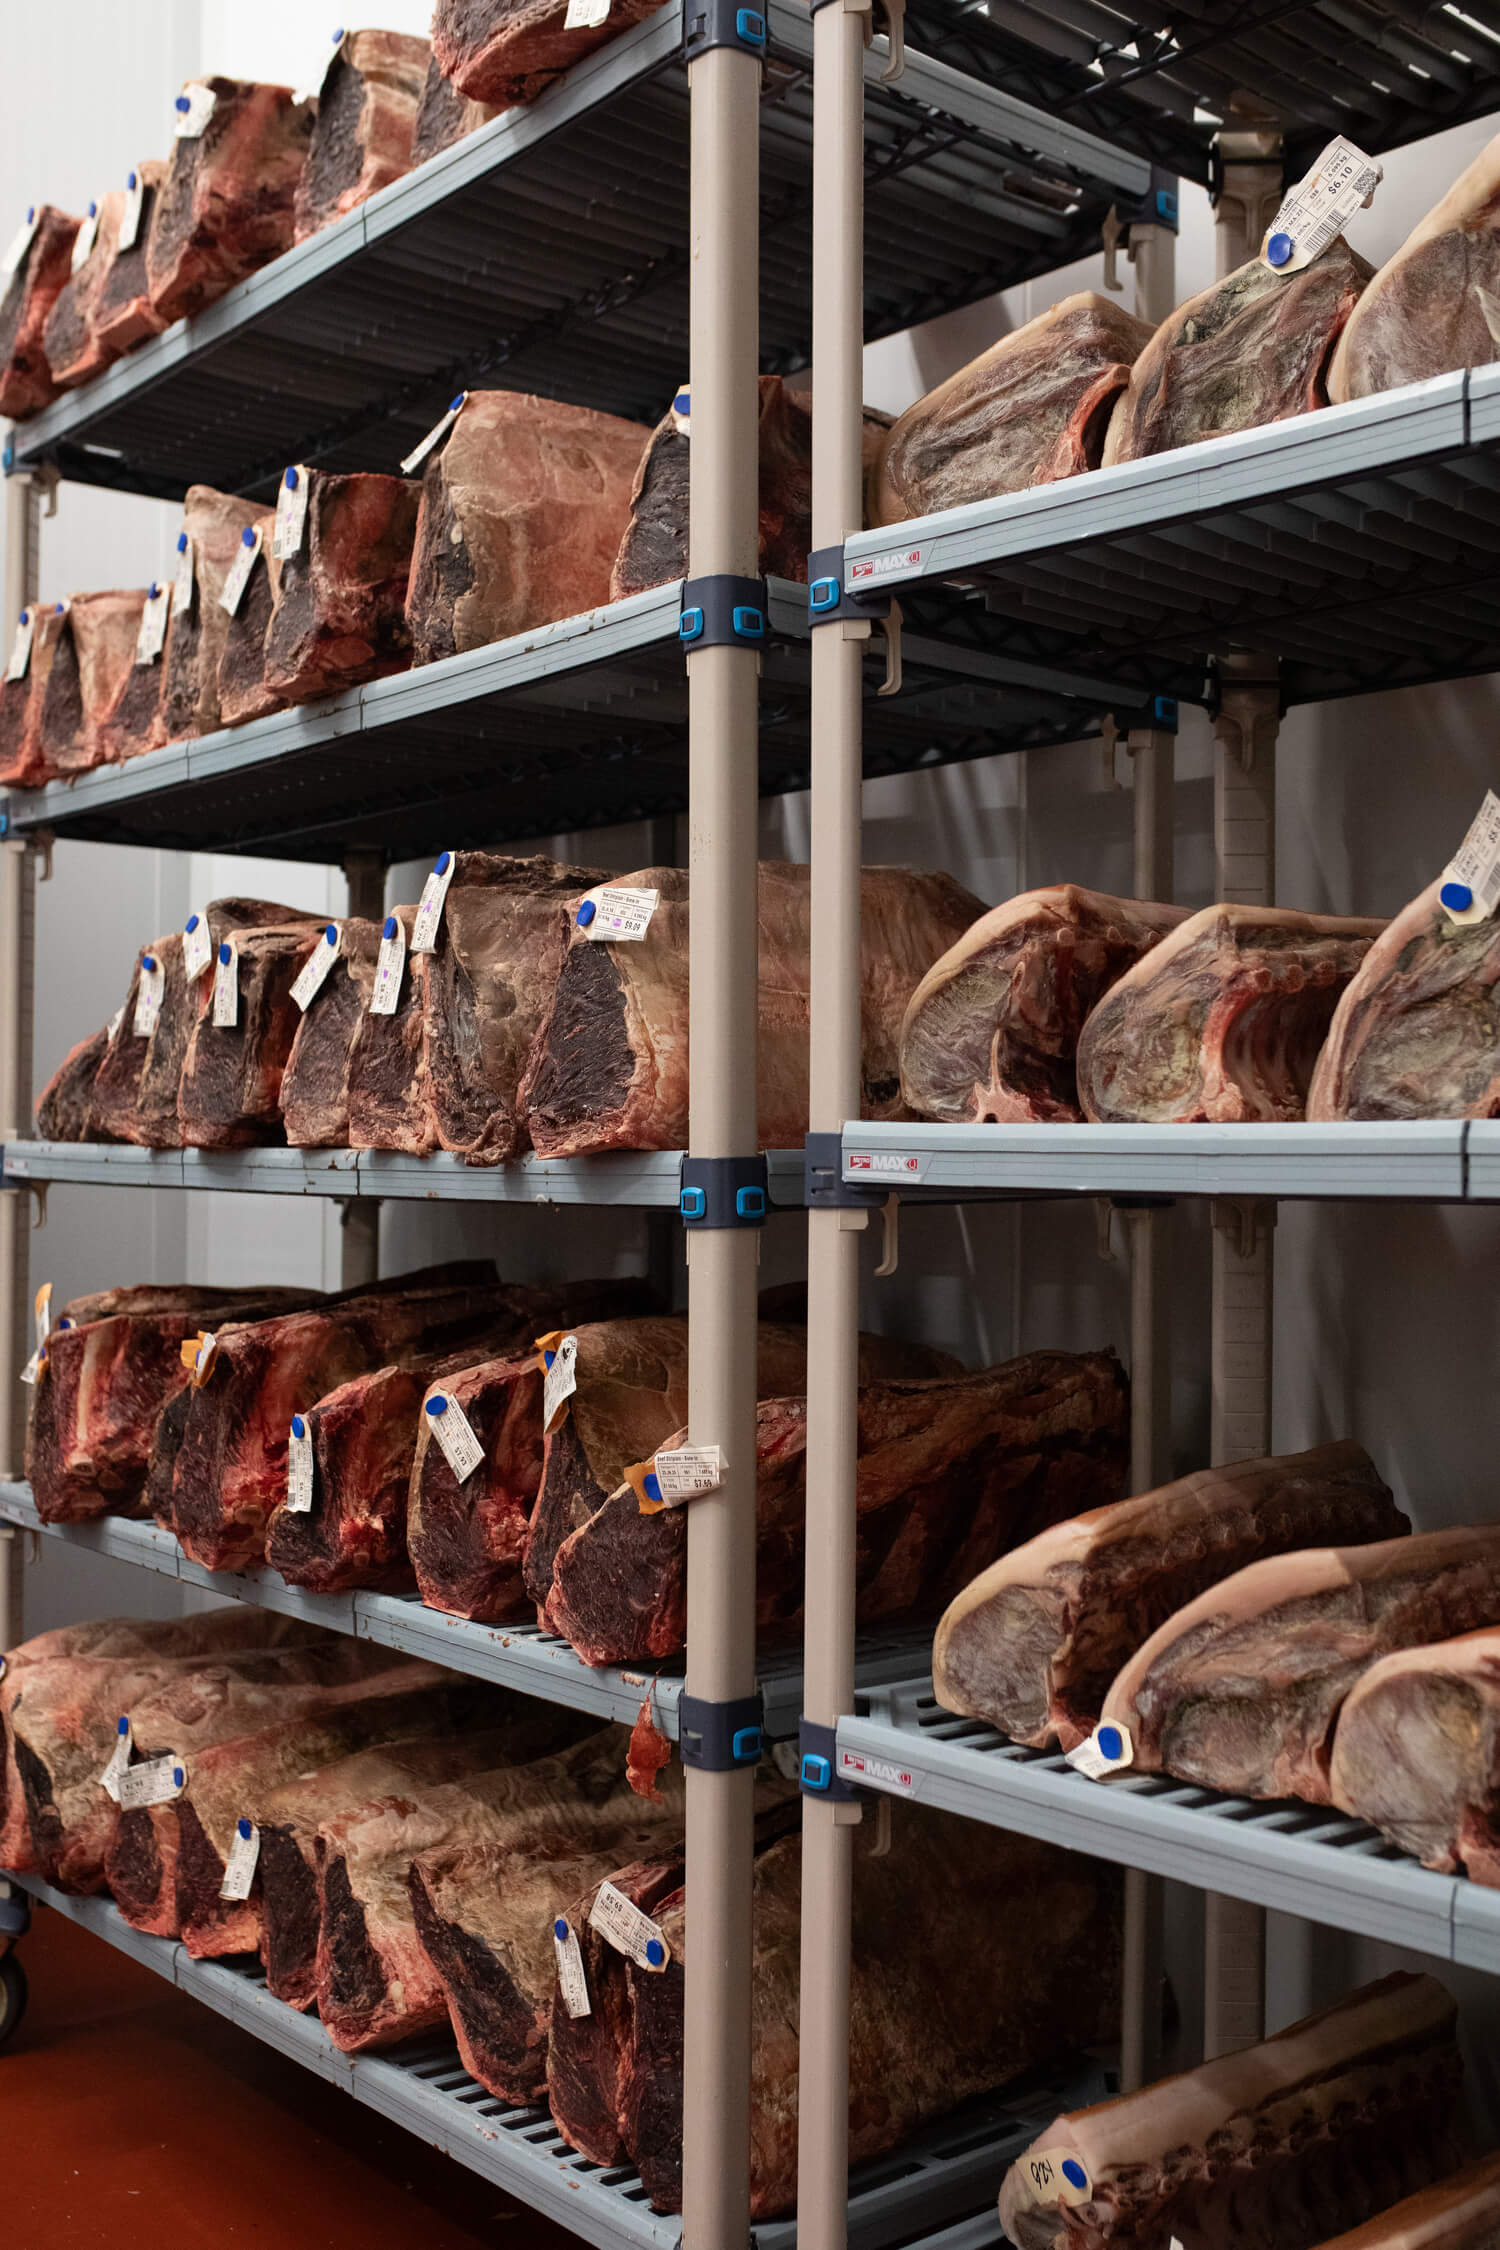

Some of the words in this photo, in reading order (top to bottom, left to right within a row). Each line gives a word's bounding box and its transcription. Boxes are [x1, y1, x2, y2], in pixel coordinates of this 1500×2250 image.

[1328, 166, 1353, 195] $6.10
[1283, 197, 1294, 212] Loin
[625, 920, 641, 932] $9.09
